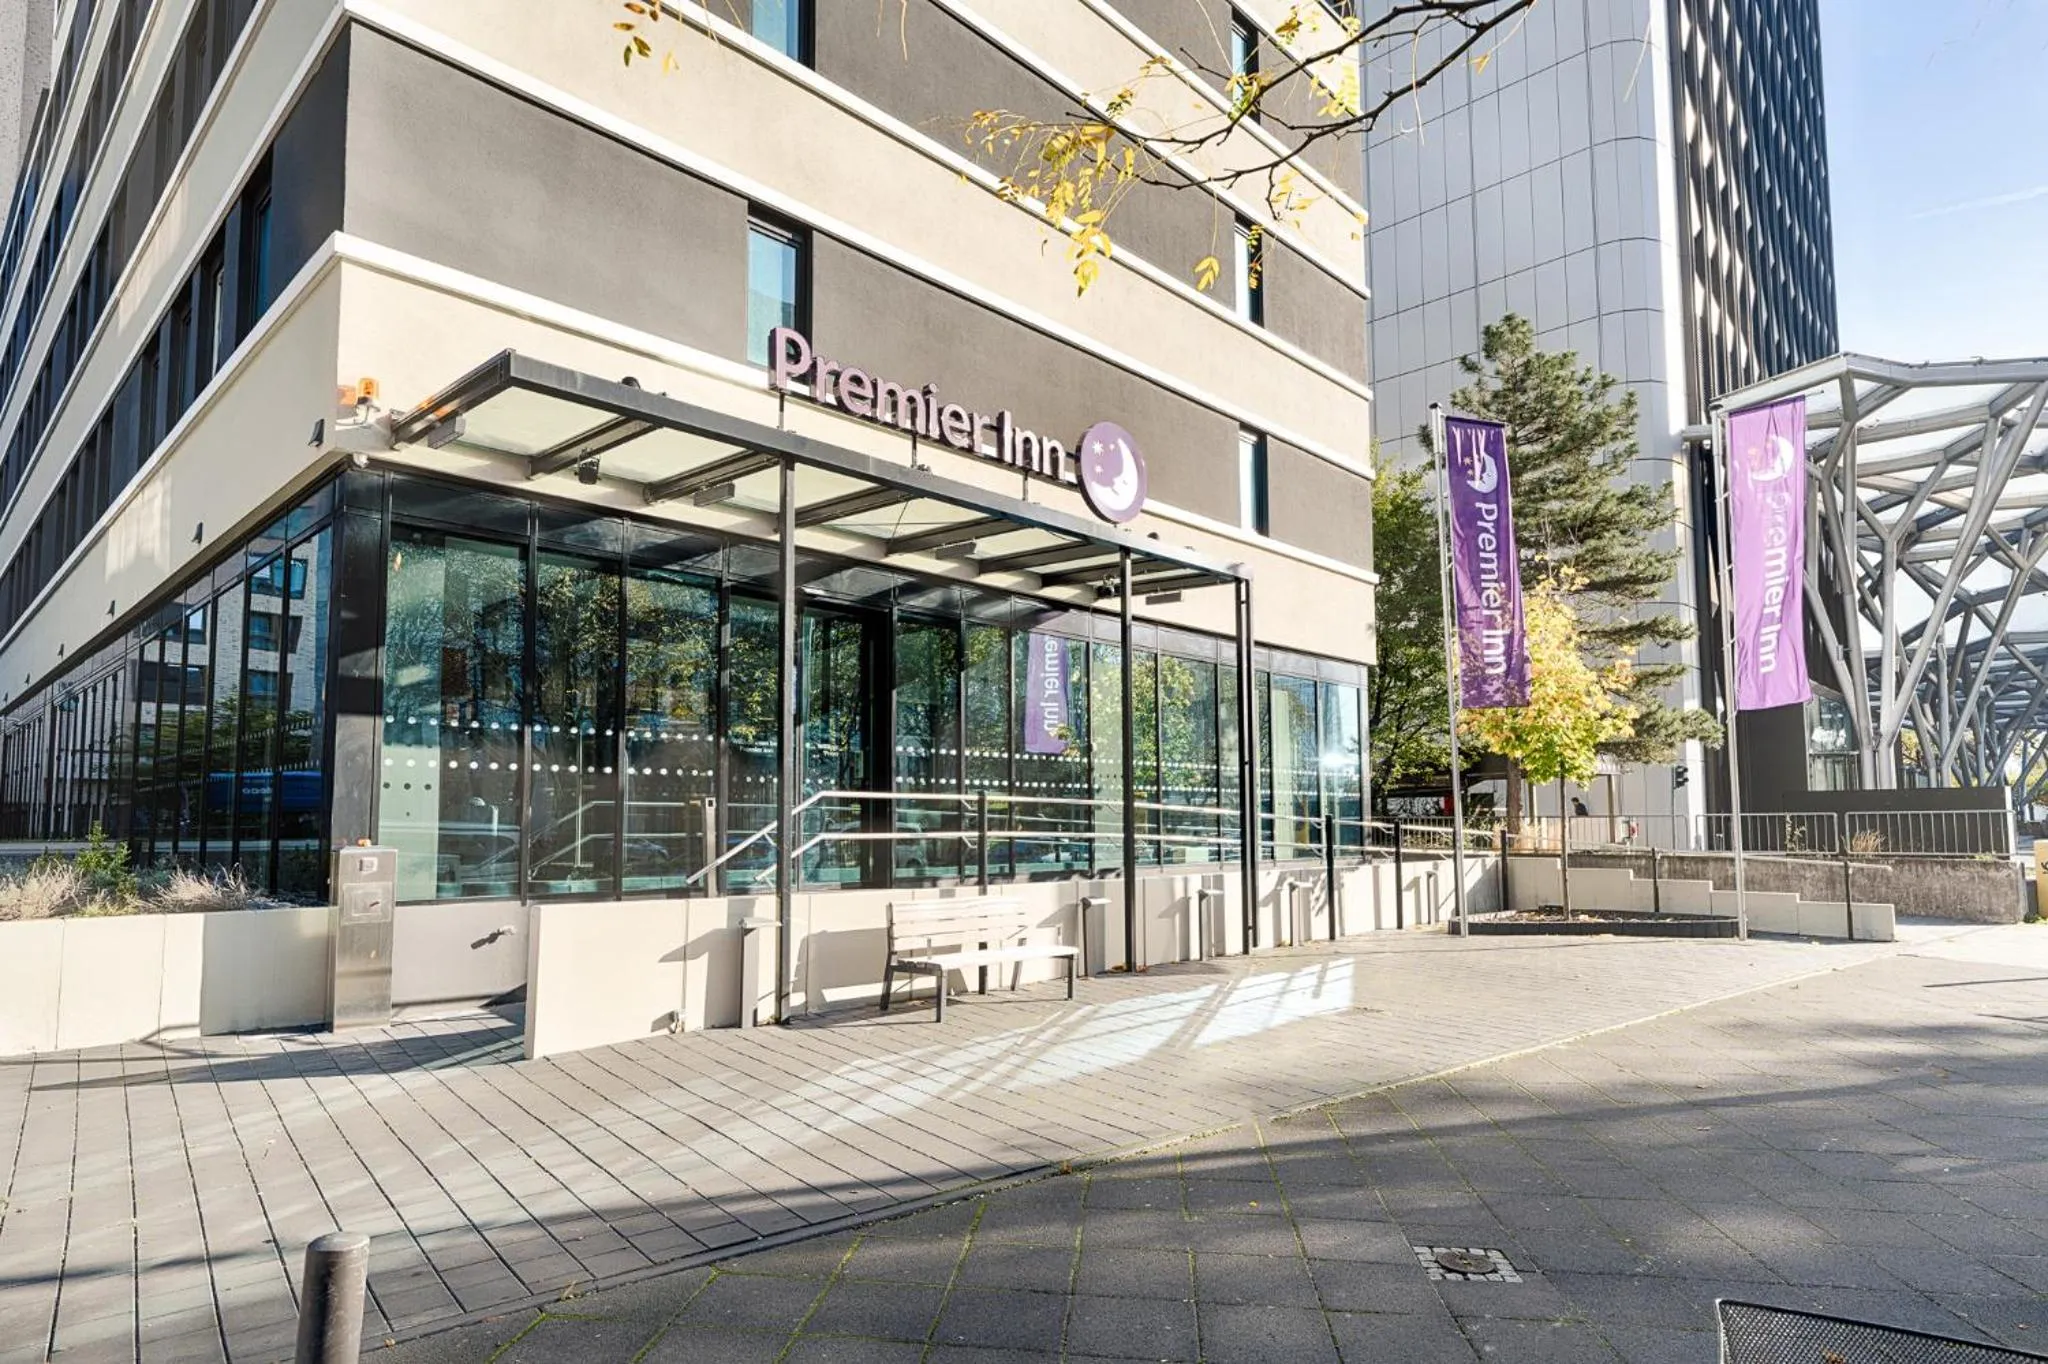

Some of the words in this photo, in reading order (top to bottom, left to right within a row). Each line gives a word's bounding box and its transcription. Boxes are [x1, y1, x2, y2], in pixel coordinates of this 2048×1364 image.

[769, 327, 993, 455] Premier
[1000, 408, 1066, 481] Inn
[1475, 501, 1506, 622] Premier
[1761, 491, 1791, 618] Premier
[1482, 629, 1508, 676] Inn
[1760, 623, 1782, 673] Inn
